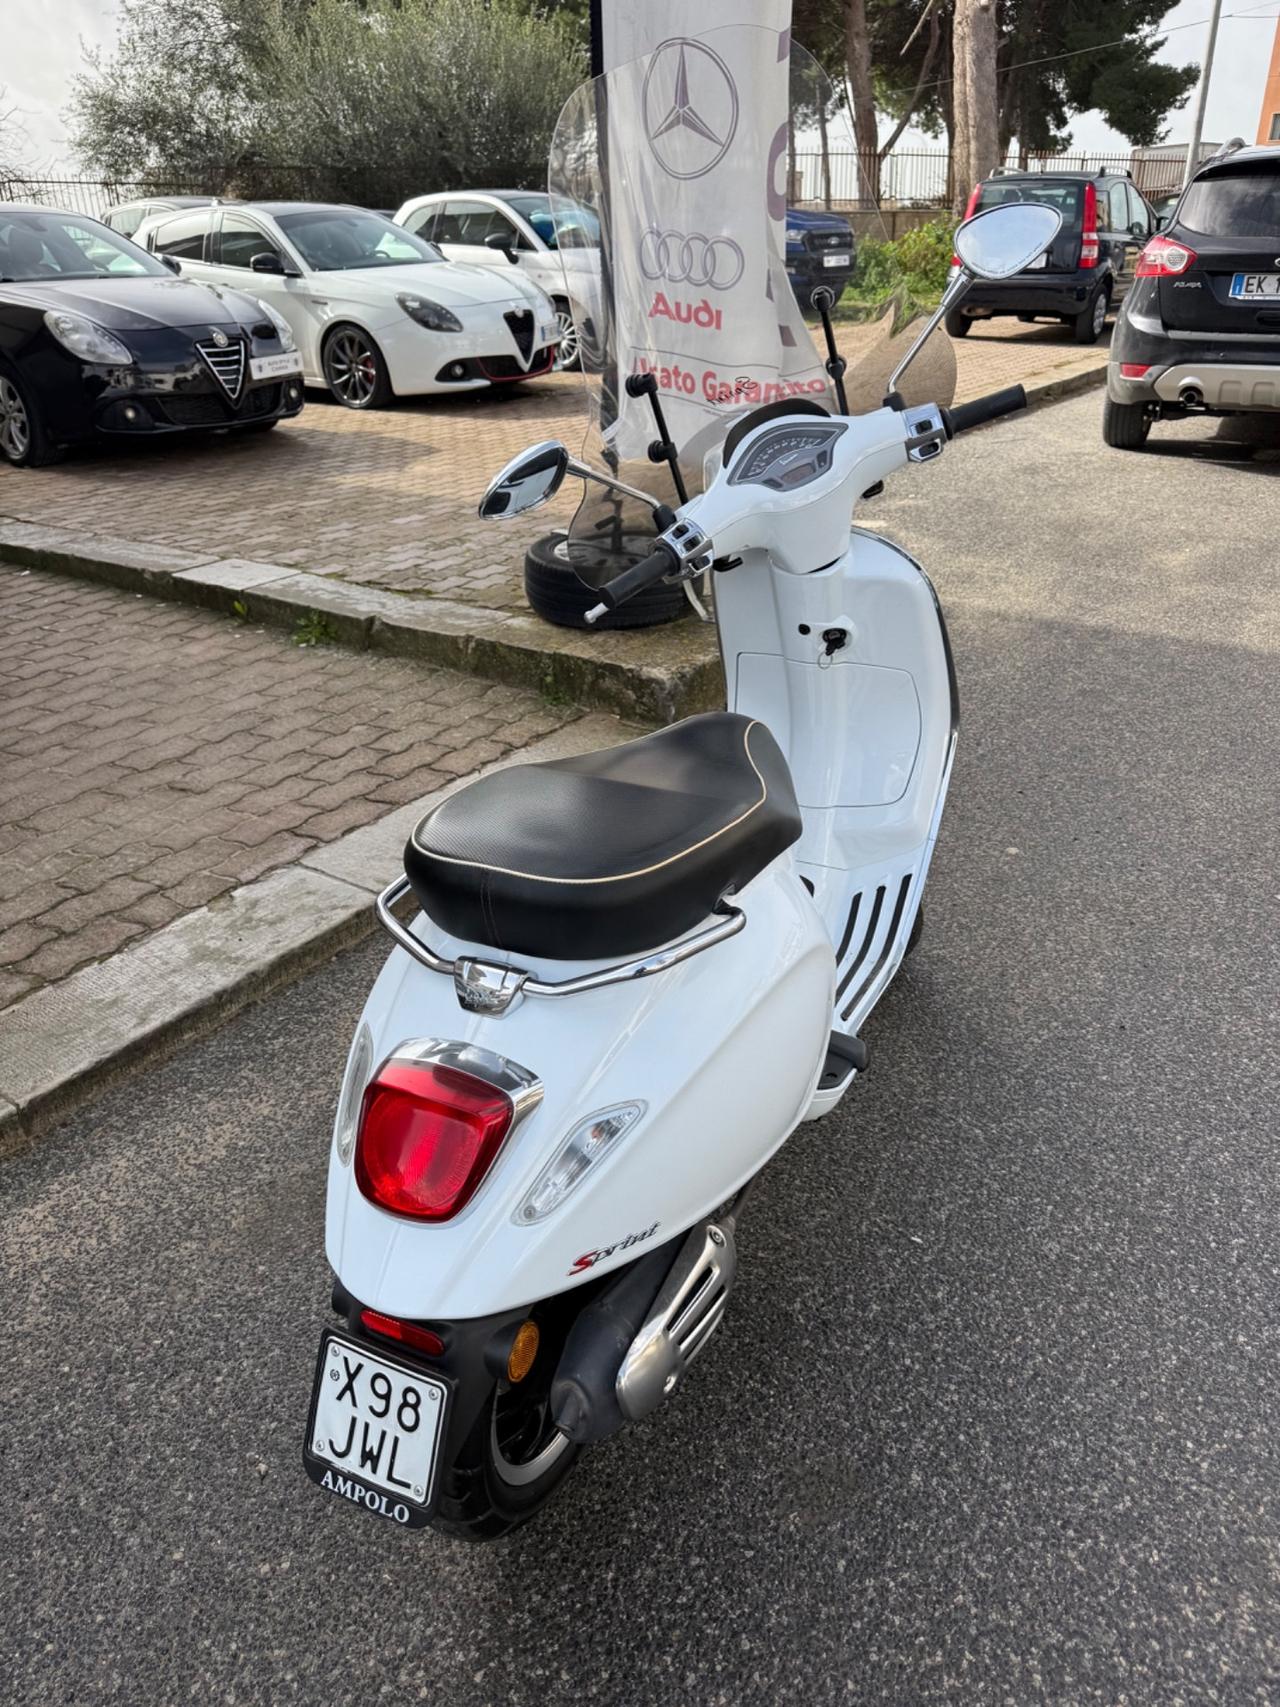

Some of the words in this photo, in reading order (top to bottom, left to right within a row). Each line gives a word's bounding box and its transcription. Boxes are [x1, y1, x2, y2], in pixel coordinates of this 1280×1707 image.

[647, 291, 722, 330] Audi
[1244, 276, 1268, 294] EK
[567, 1220, 661, 1276] Sprint
[335, 1355, 421, 1433] X98
[328, 1415, 412, 1490] JWL
[320, 1470, 410, 1524] AMPOLO
